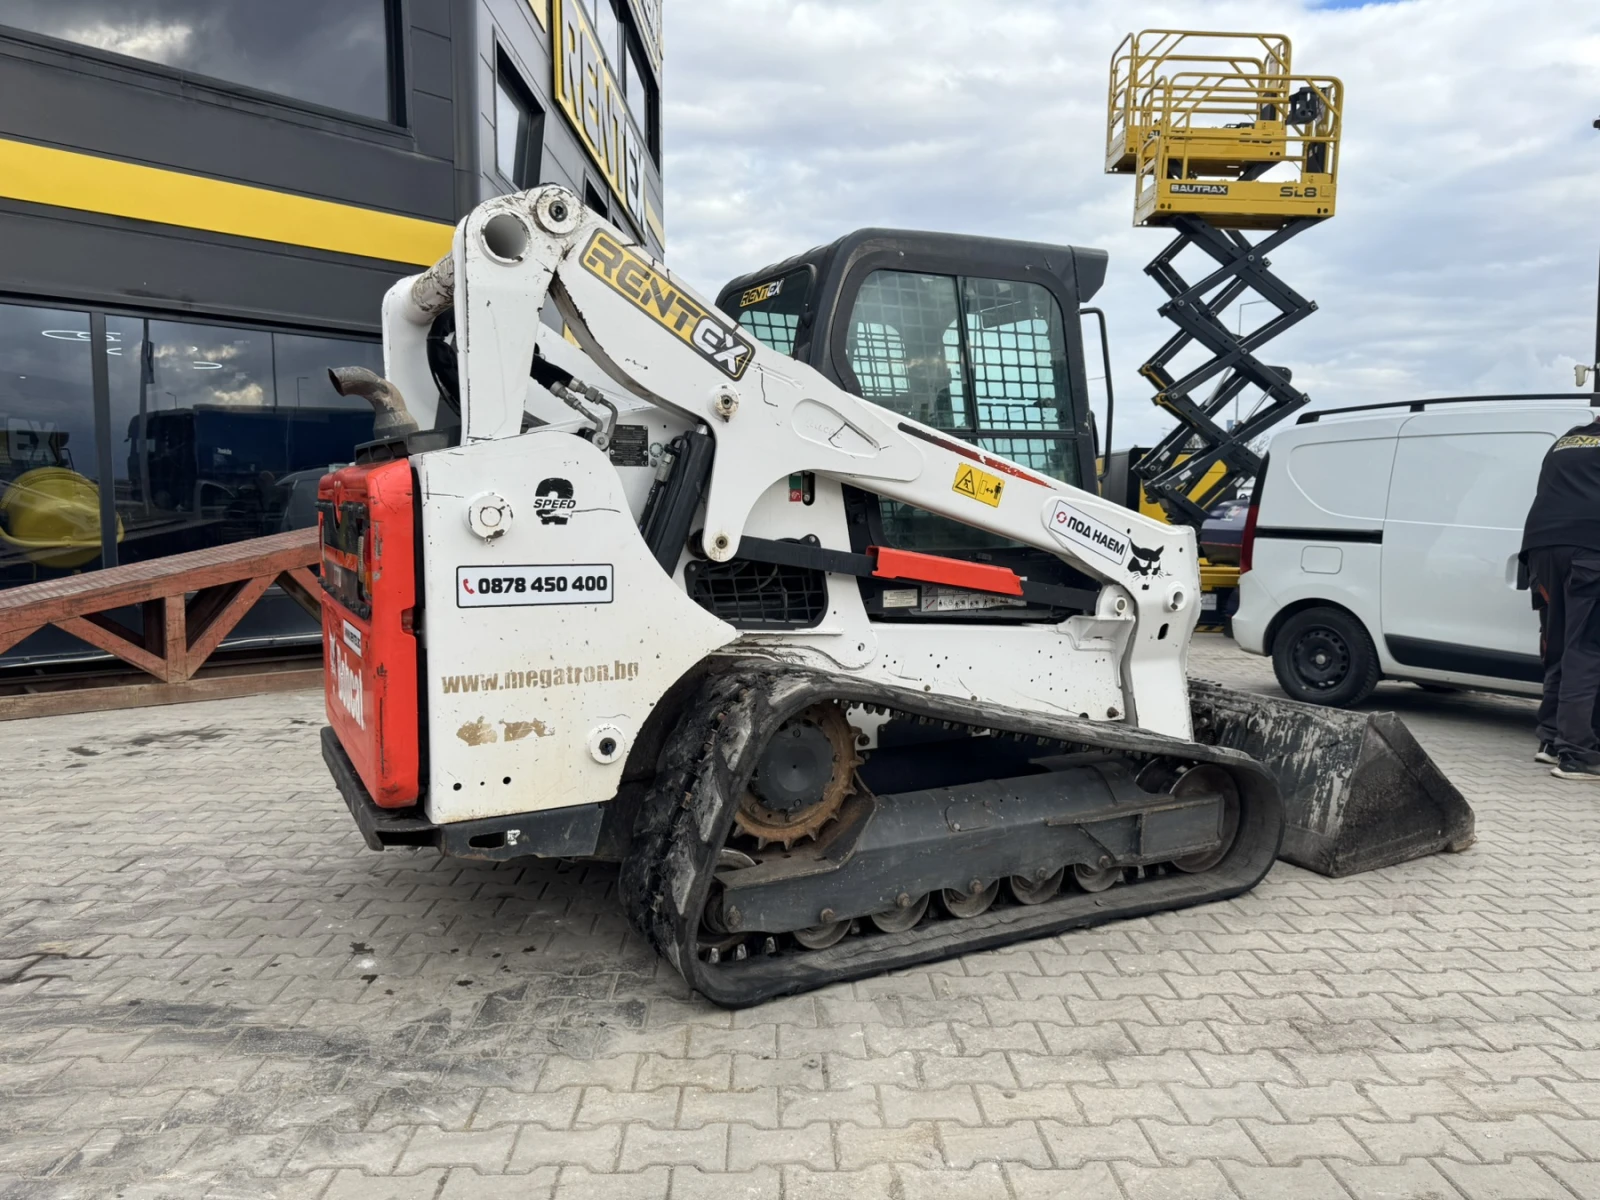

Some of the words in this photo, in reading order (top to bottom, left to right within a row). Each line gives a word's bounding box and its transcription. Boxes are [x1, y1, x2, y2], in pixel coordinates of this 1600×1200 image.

[561, 0, 647, 240] RENTEX
[1171, 184, 1227, 195] BAUTRAX
[1280, 187, 1317, 197] SL8
[740, 278, 785, 307] RENTEX
[586, 236, 748, 374] RENTEX
[1555, 435, 1600, 449] RENT
[533, 499, 576, 509] SPEED
[1067, 516, 1092, 538] ПОД
[1092, 529, 1125, 556] НАЕМ
[478, 578, 526, 594] 0878
[531, 577, 568, 592] 450
[572, 576, 608, 591] 400
[441, 660, 639, 694] www.megatron.bg
